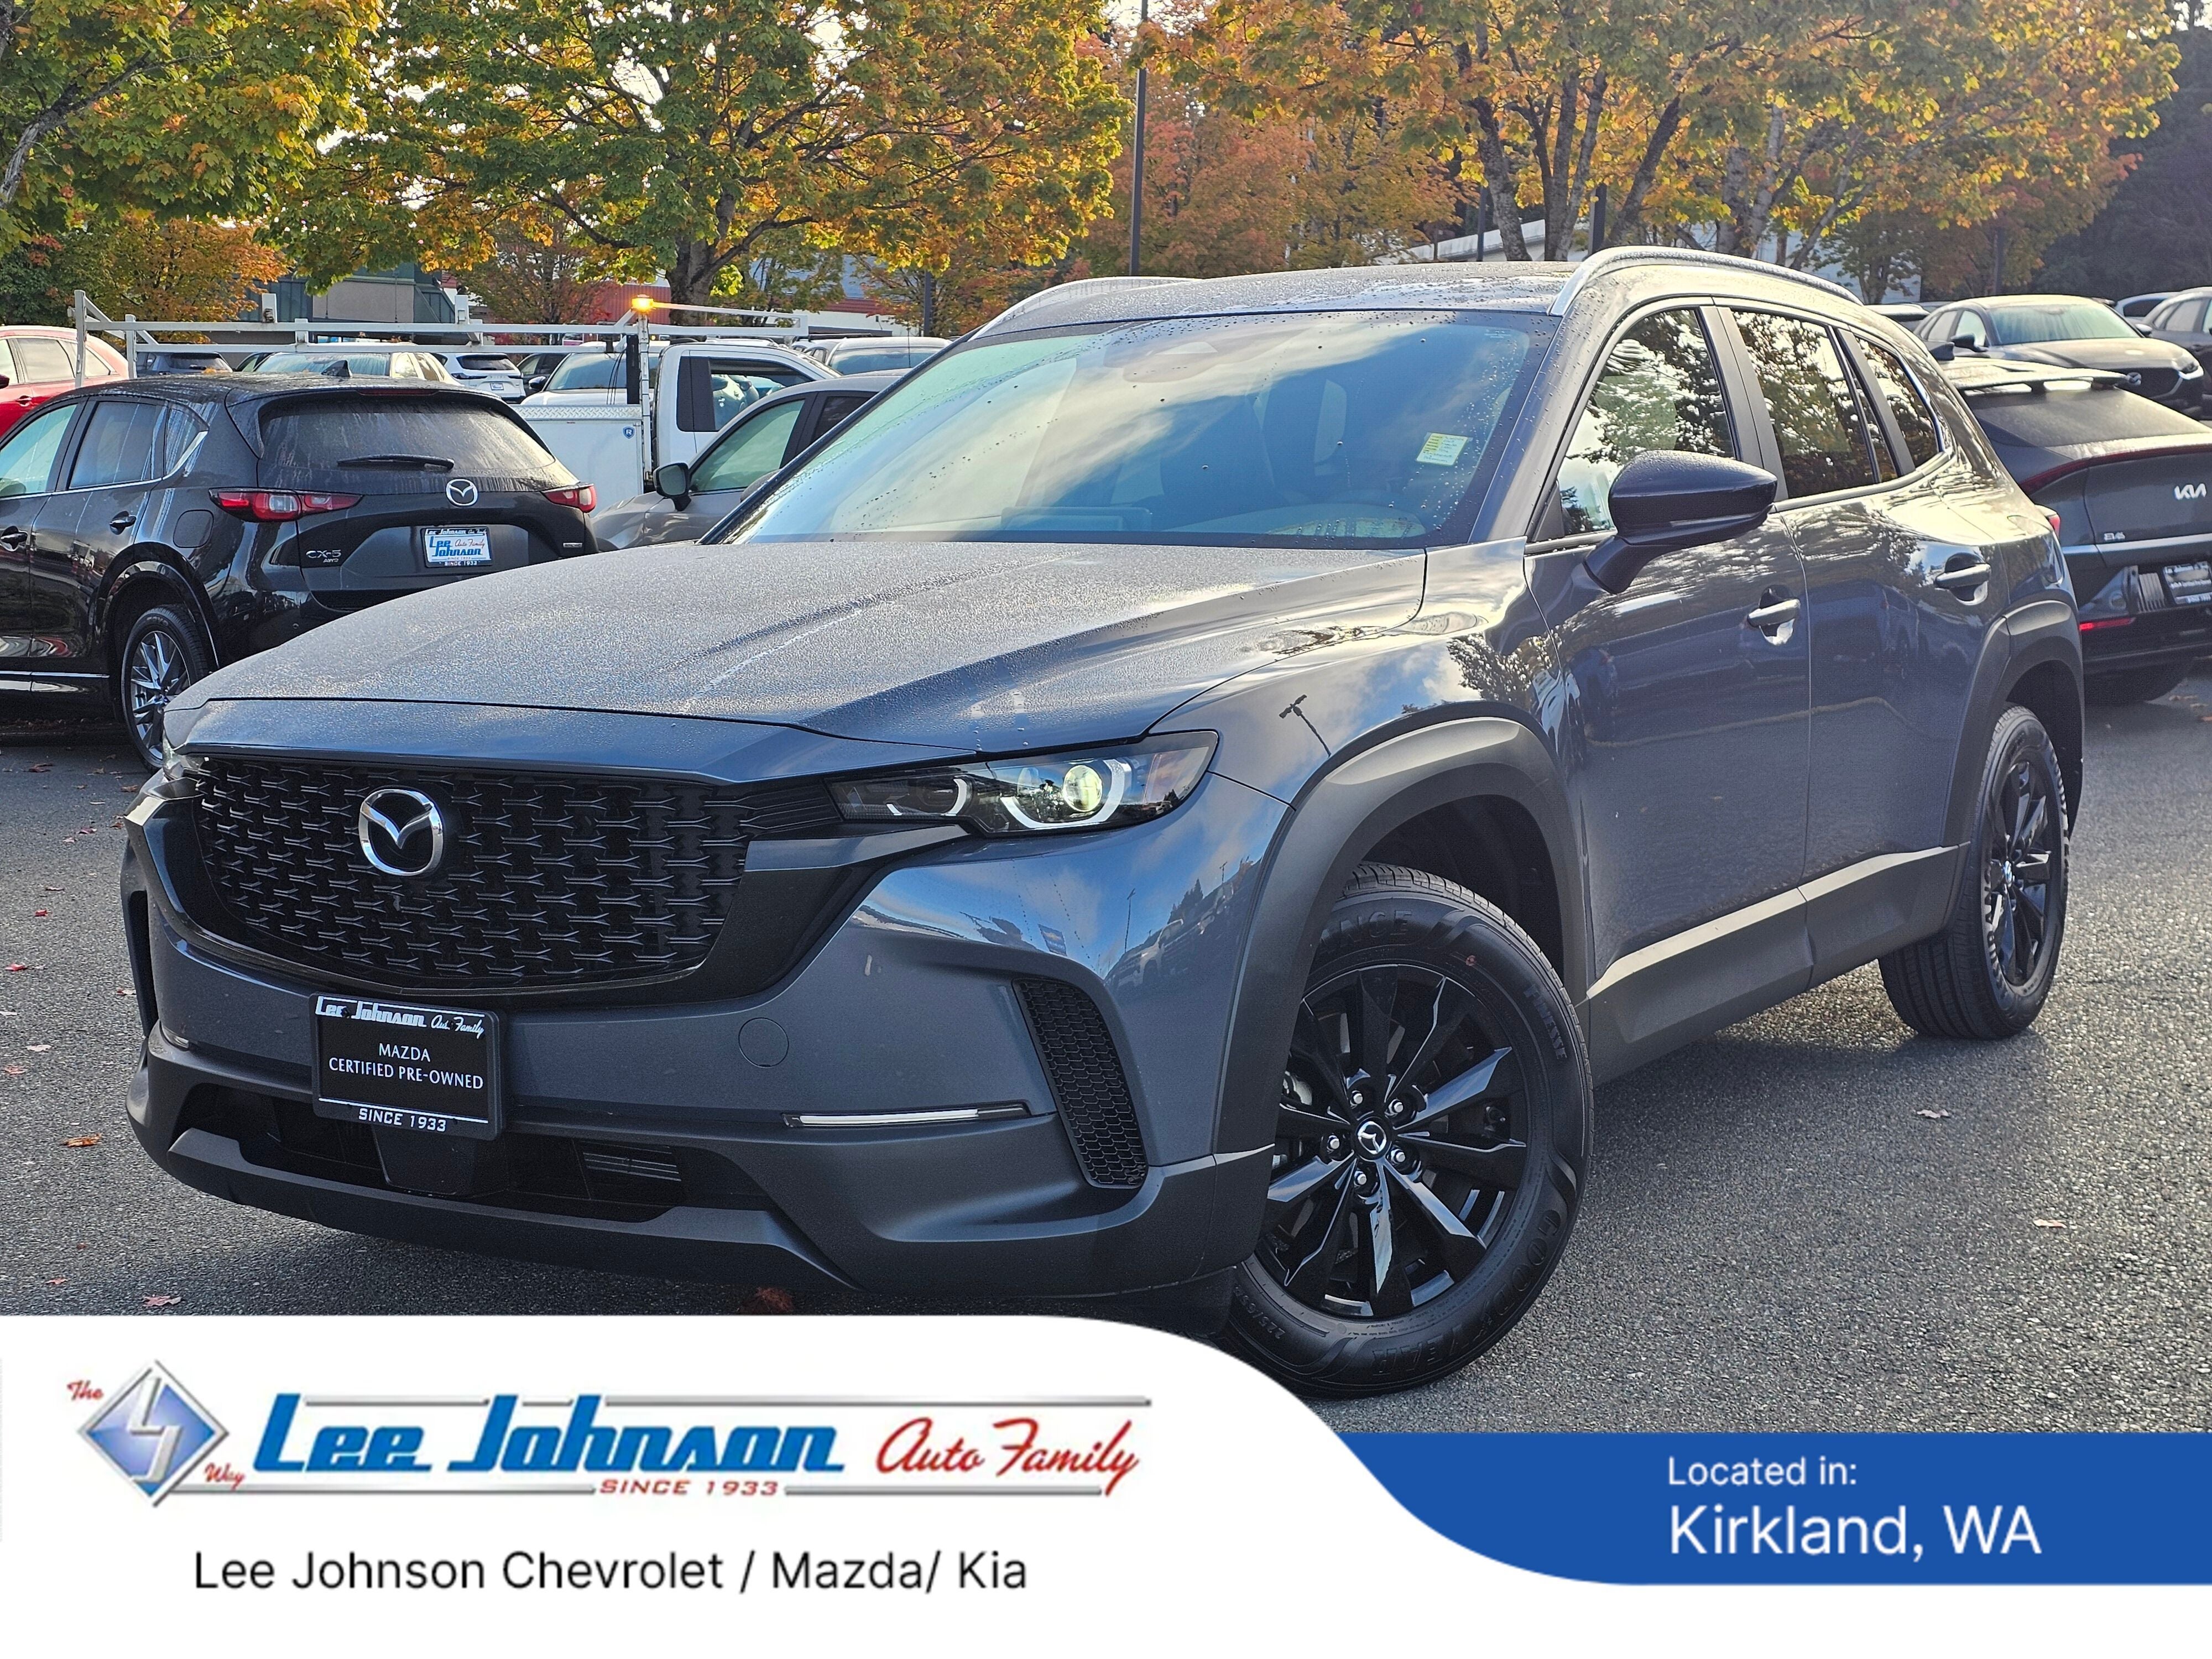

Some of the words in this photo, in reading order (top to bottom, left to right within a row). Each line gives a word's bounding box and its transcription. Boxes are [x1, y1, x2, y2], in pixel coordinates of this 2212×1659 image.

[2174, 483, 2206, 500] KIA
[429, 536, 453, 548] Lee
[431, 544, 483, 557] Johnson
[455, 539, 468, 547] Auto
[468, 538, 485, 549] Family
[306, 549, 342, 559] CX-5
[351, 1000, 427, 1027] Johnson
[431, 1014, 451, 1030] Aut
[453, 1016, 485, 1039] Family
[1523, 983, 1568, 1060] FINESSE
[379, 1042, 431, 1062] MAZDA
[328, 1057, 394, 1078] CERTIFIED
[398, 1066, 484, 1089] PRE-OWNED
[358, 1108, 403, 1126] SINCE
[410, 1115, 447, 1132] 1933
